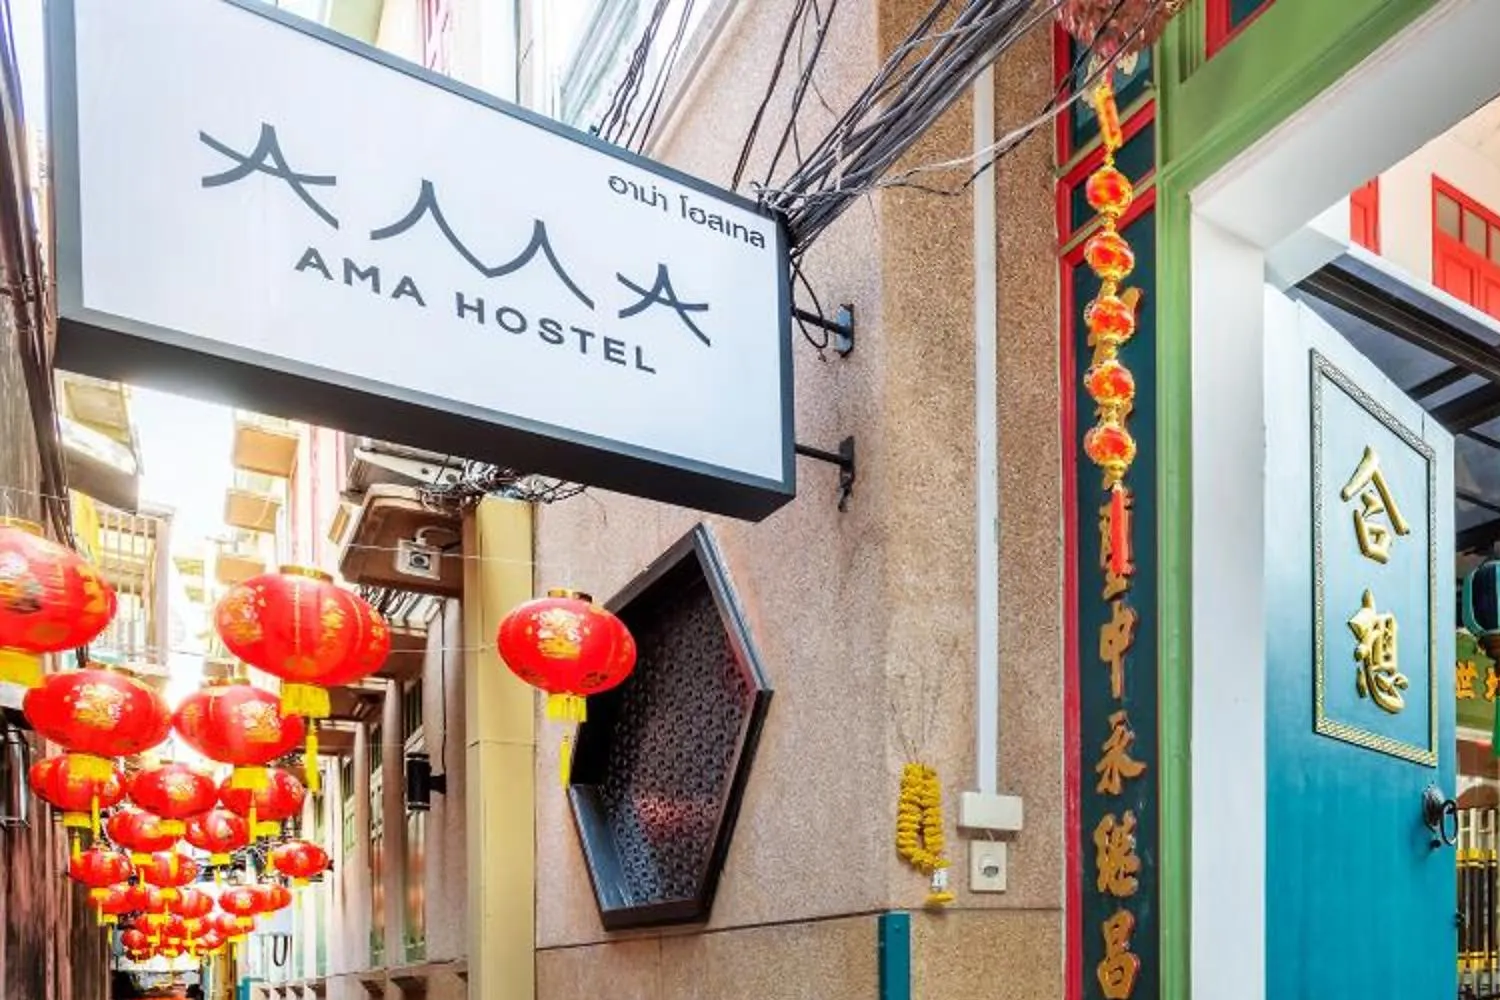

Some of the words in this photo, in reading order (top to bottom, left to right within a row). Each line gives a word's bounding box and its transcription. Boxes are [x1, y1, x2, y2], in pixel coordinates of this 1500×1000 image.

[607, 175, 669, 212] อาม่า
[295, 247, 426, 307] AMA
[455, 292, 657, 374] HOSTEL
